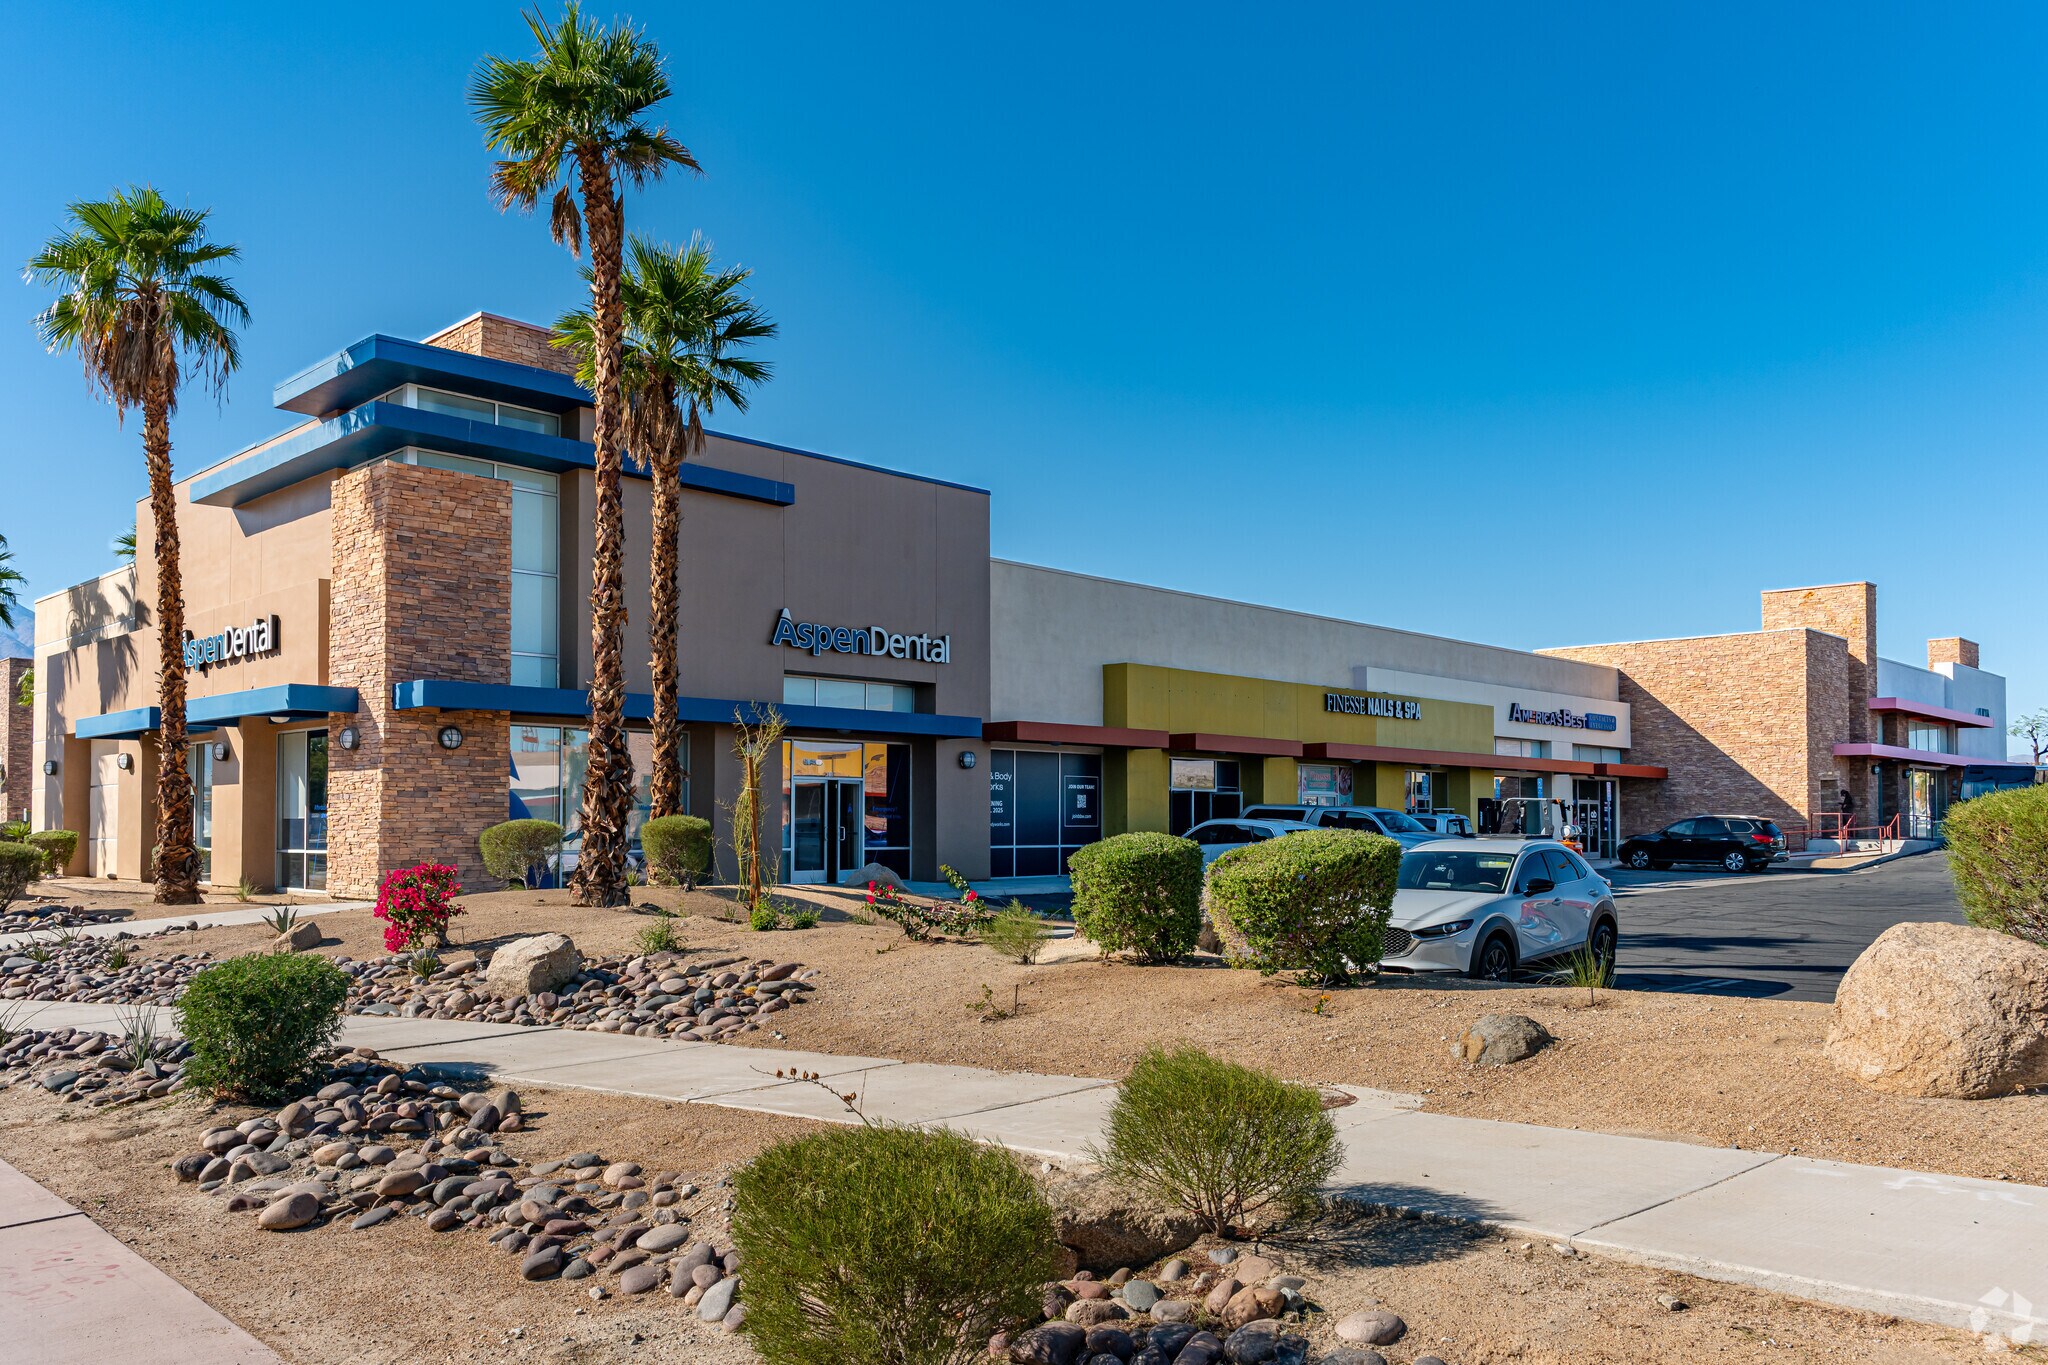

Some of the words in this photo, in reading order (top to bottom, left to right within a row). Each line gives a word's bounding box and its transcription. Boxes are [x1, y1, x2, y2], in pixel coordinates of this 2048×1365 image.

[1325, 693, 1366, 715] FINESSE
[1368, 697, 1394, 717] NAILS
[1395, 701, 1404, 719] &
[1404, 701, 1422, 720] SPA
[995, 772, 1012, 782] Body
